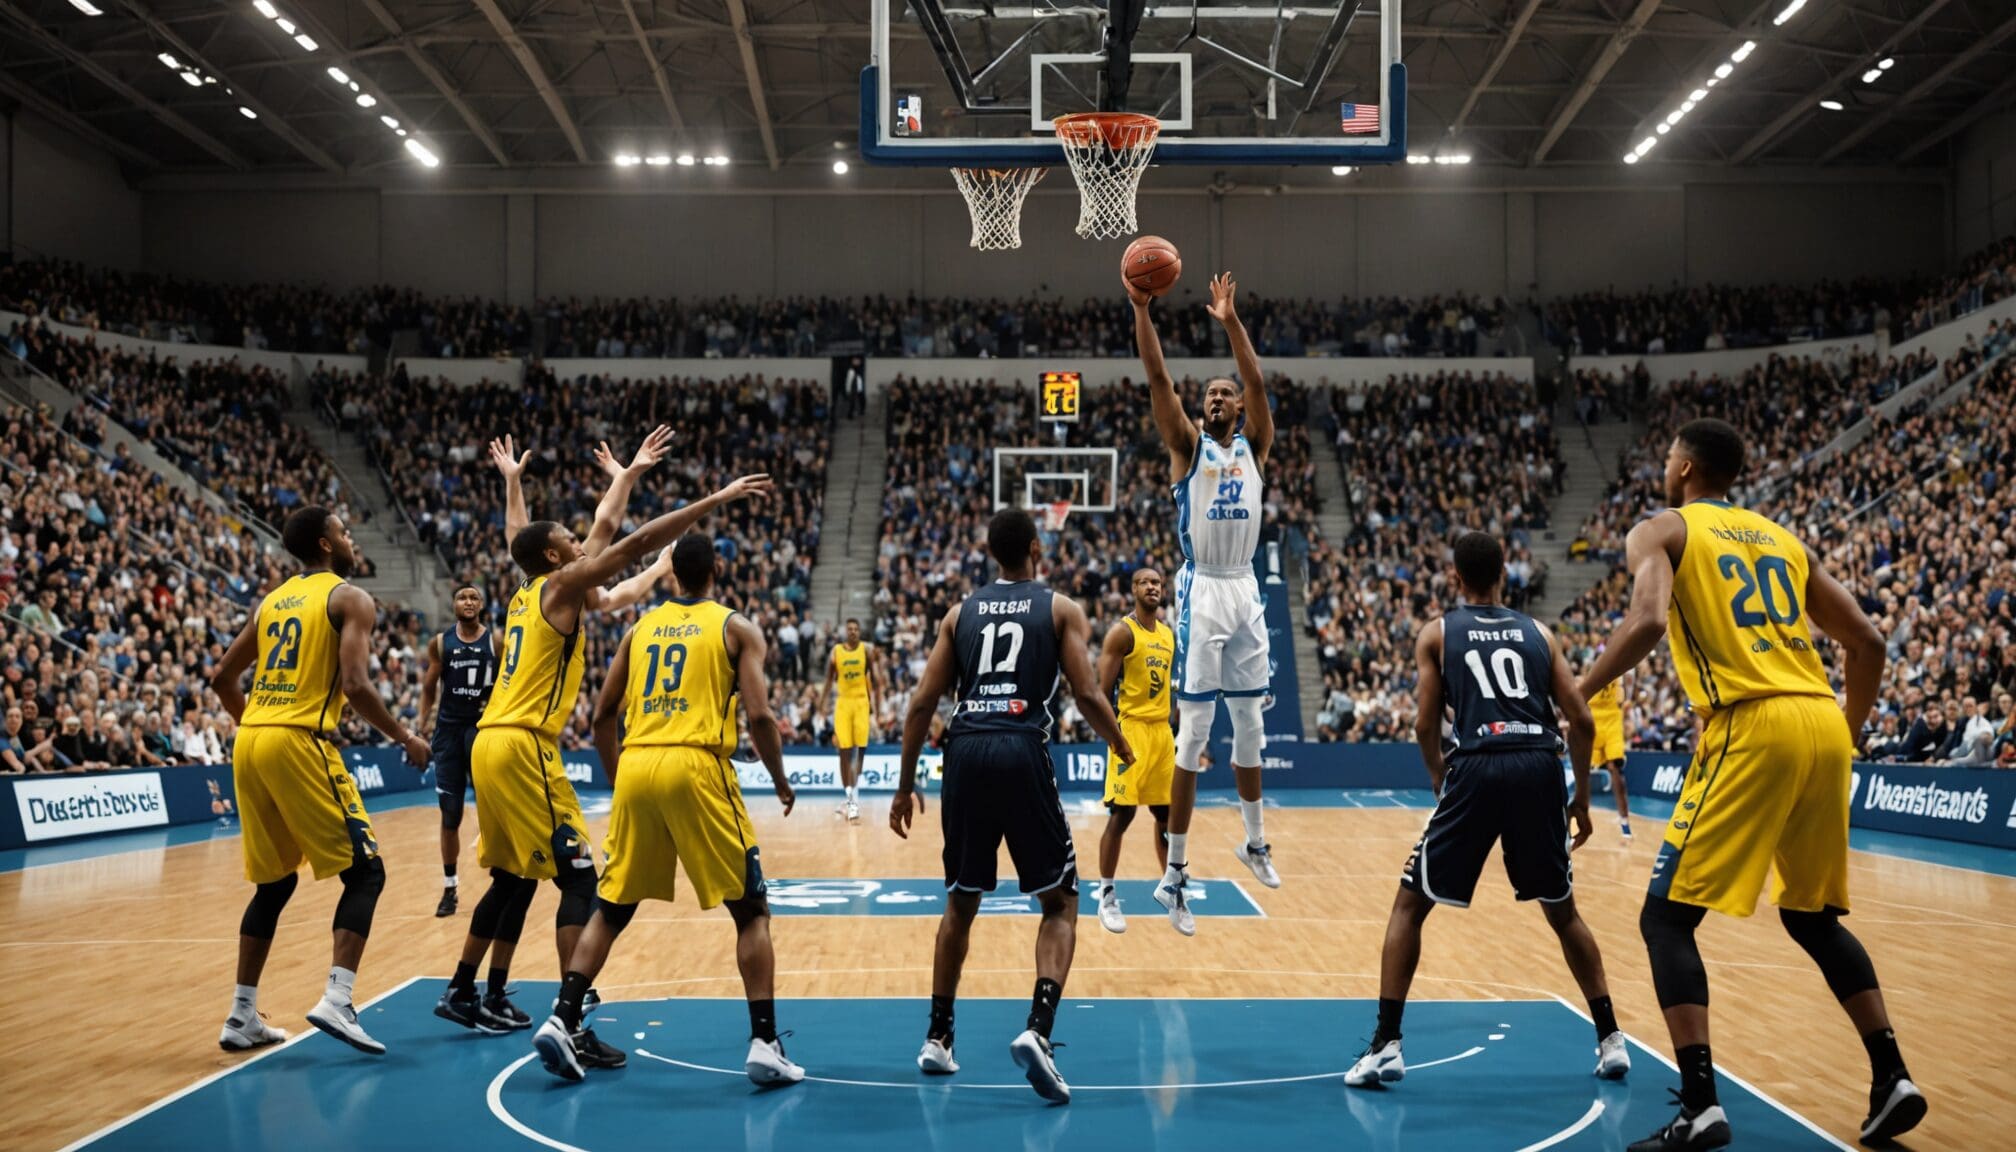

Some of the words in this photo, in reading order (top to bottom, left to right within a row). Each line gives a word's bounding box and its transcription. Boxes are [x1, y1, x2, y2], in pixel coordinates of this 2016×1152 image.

[1717, 554, 1801, 628] 20
[643, 643, 687, 698] 19
[977, 621, 1024, 675] 12
[1464, 647, 1529, 699] 10
